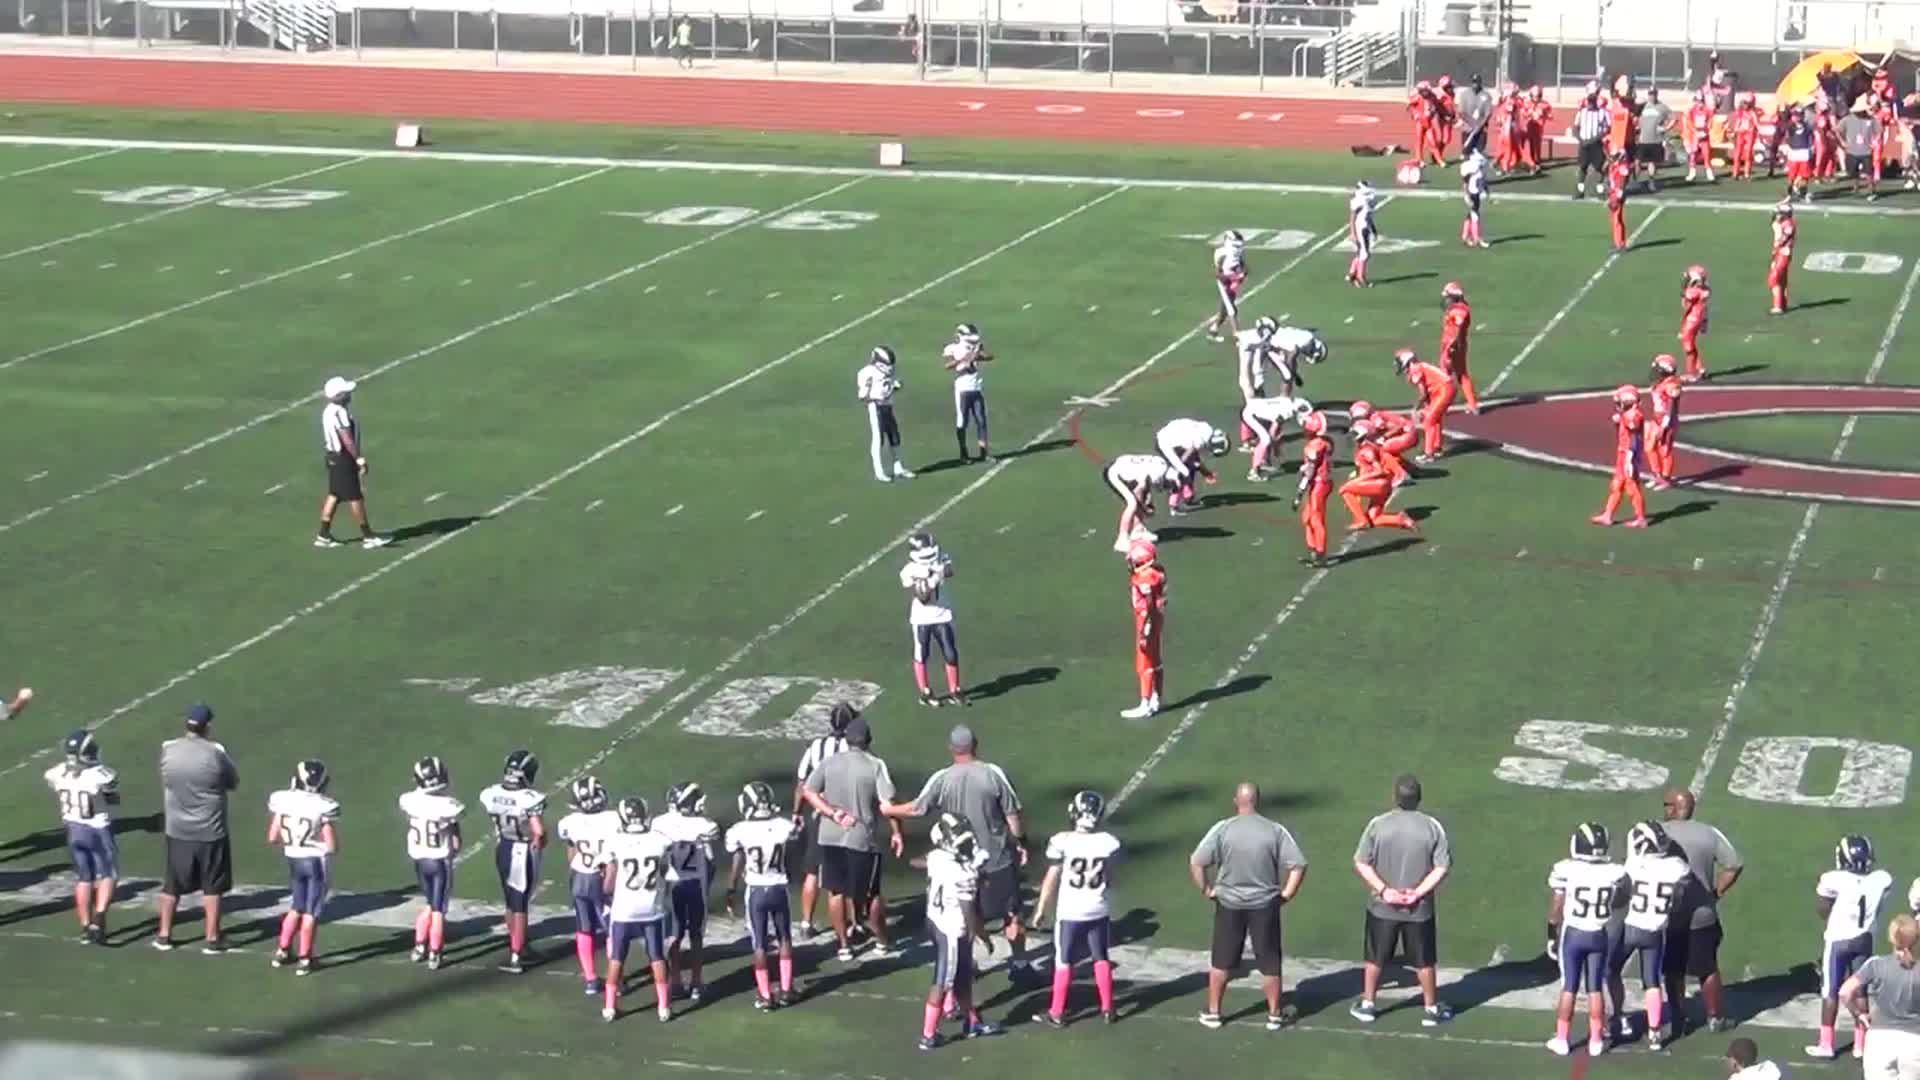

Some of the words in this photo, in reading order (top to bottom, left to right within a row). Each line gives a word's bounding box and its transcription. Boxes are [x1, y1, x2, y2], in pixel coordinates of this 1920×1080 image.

[467, 665, 883, 738] 40
[1493, 719, 1912, 807] 50
[280, 814, 314, 848] 52
[623, 856, 660, 891] 22
[748, 843, 785, 874] 34
[1573, 886, 1610, 919] 58
[1631, 880, 1673, 915] 55
[1857, 894, 1867, 929] 1
